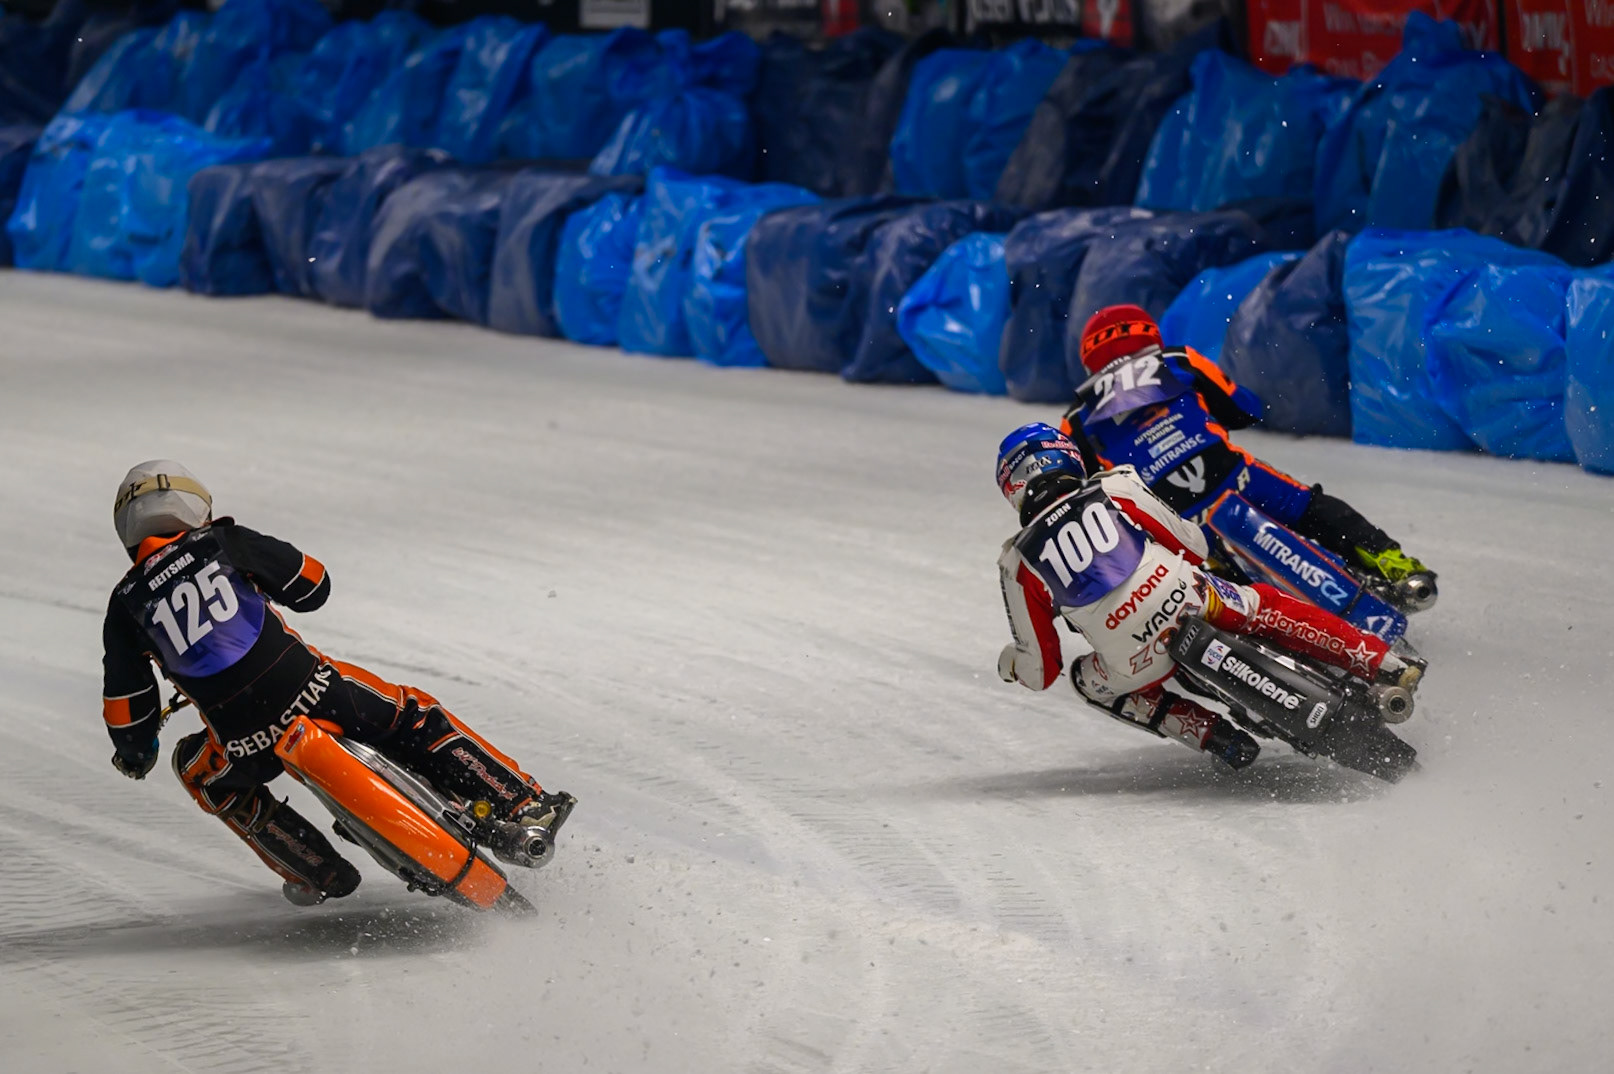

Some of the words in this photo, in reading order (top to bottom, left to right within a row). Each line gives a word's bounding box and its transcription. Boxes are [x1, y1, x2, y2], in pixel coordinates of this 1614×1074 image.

[1093, 354, 1163, 410] 212
[1044, 502, 1072, 527] ZORN
[148, 552, 195, 592] REITSMA
[1038, 501, 1120, 589] 100
[151, 560, 239, 656] 125
[1104, 563, 1170, 631] daytona
[1131, 588, 1187, 643] WACO
[1267, 608, 1346, 654] daytona
[1221, 655, 1300, 711] Silkolene
[226, 664, 332, 759] SEBASTIAN
